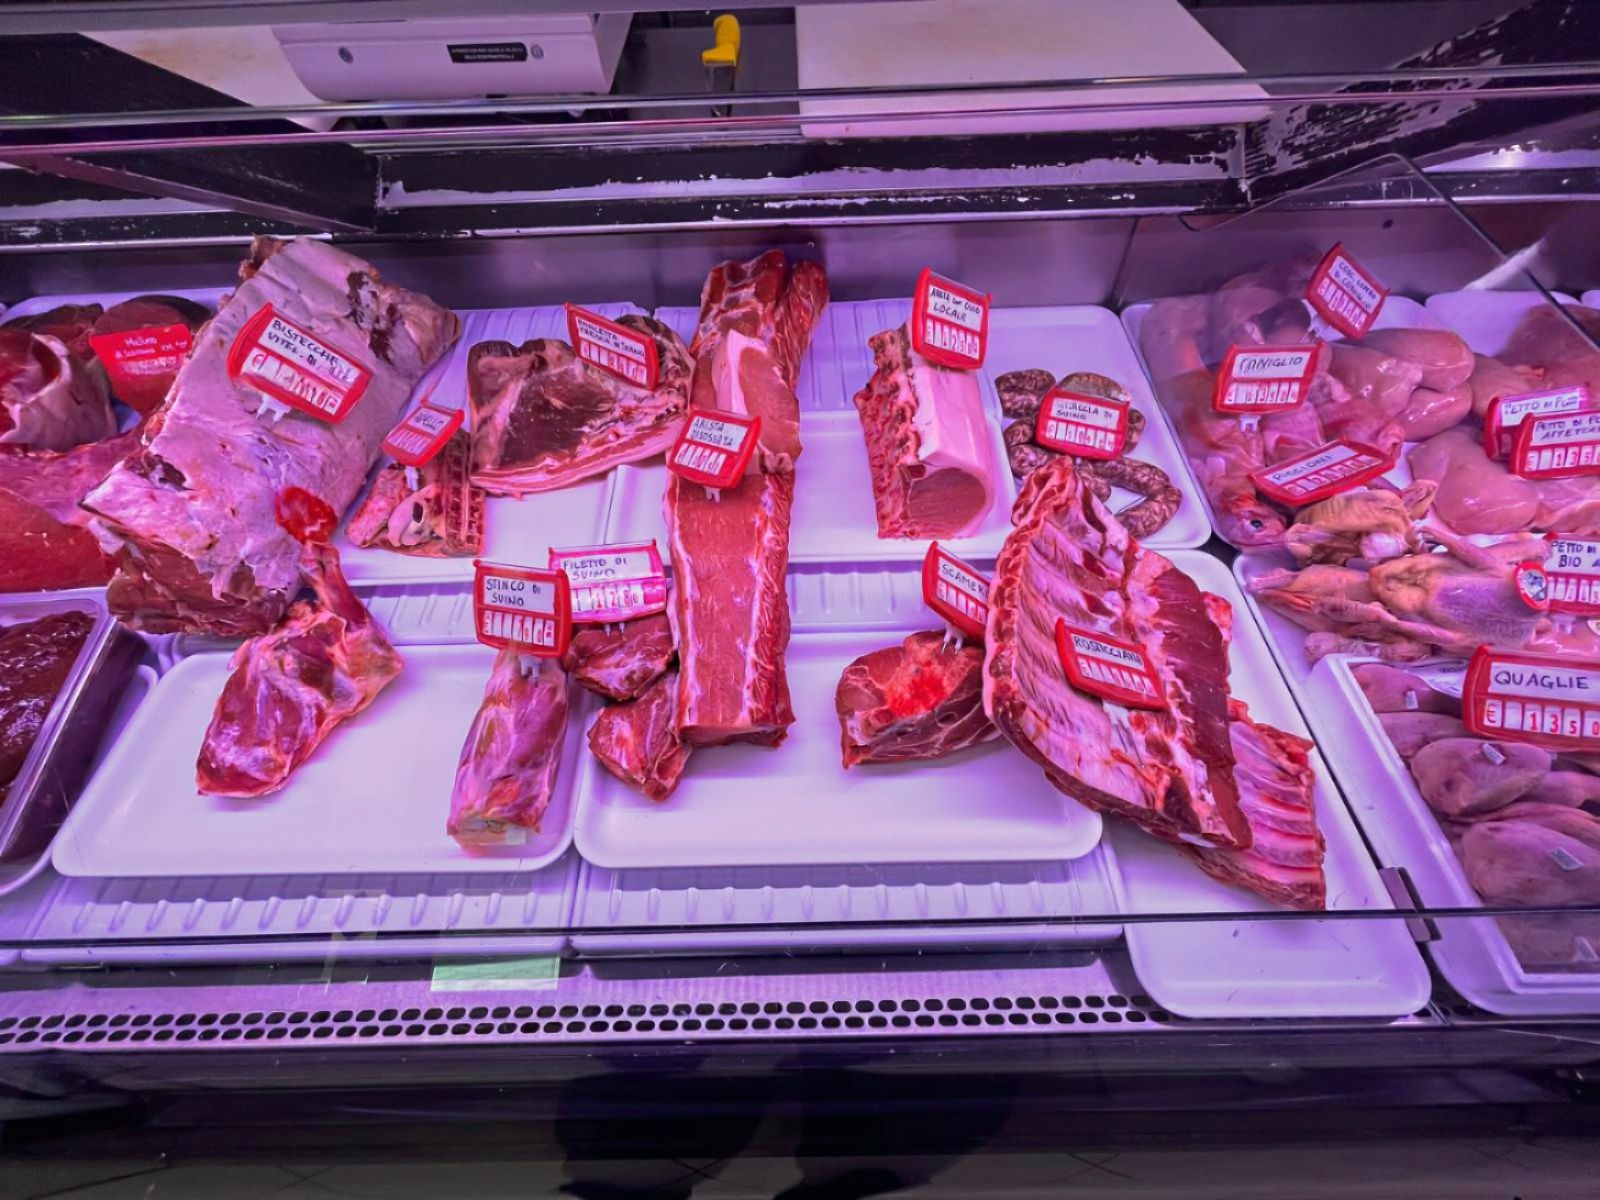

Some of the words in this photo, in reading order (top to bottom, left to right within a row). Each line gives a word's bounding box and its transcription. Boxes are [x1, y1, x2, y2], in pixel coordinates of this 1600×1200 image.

[563, 557, 607, 571] FILETTO
[1559, 554, 1581, 568] BIO
[572, 570, 615, 581] SUINO
[942, 564, 990, 596] SCAMER
[486, 579, 524, 592] STINCO
[491, 593, 524, 606] SUINO
[1495, 671, 1590, 689] QUAGLIE
